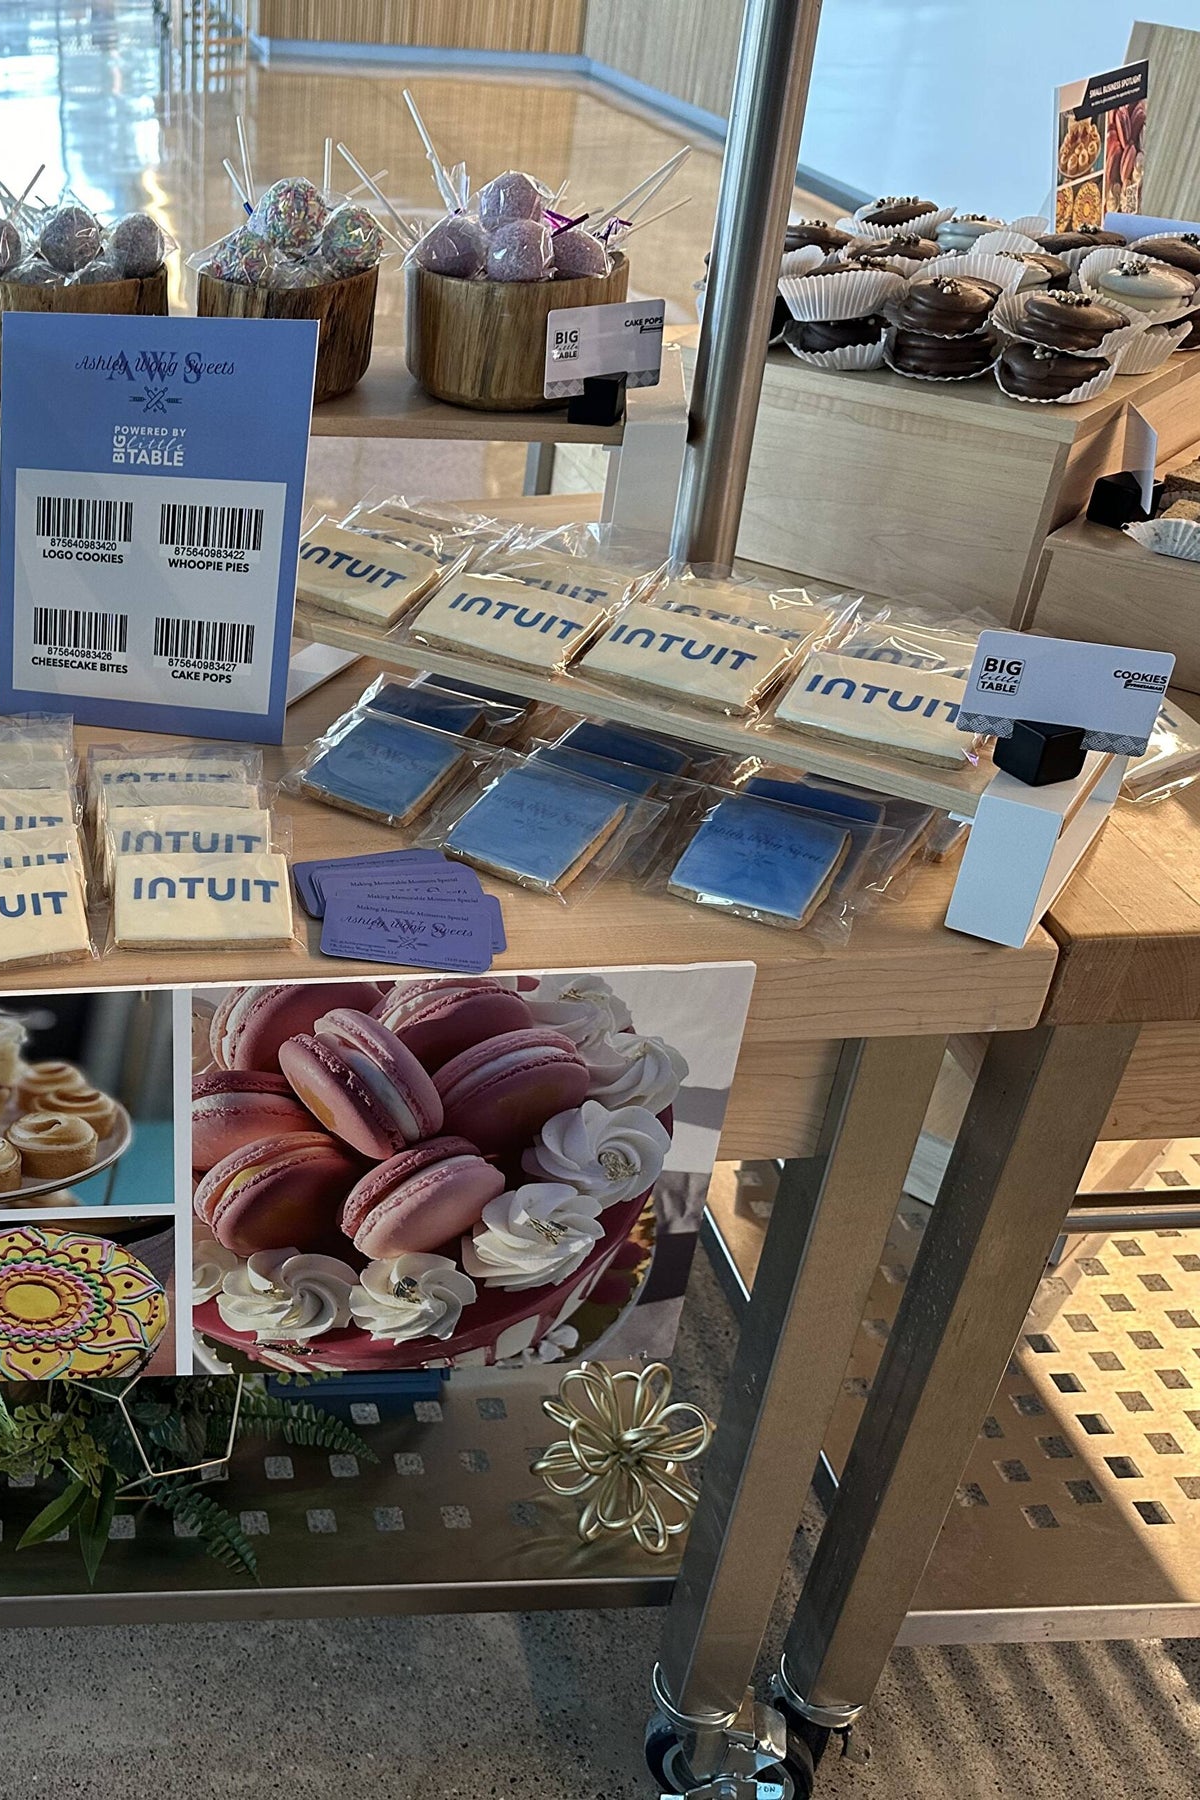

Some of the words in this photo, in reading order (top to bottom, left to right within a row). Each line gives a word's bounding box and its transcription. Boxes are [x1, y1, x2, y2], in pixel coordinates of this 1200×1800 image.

[624, 319, 642, 327] CAKE
[644, 317, 663, 325] POPS
[556, 330, 578, 344] BIG
[554, 350, 577, 359] ABLE
[114, 425, 168, 437] POWERED
[171, 428, 186, 437] BY
[112, 435, 127, 463] BIG
[126, 435, 185, 452] little
[128, 449, 184, 467] TABLE
[50, 538, 117, 553] 875640983420
[174, 546, 245, 560] 875640983422
[42, 550, 73, 562] LOGO
[76, 552, 124, 565] COOKIES
[300, 542, 407, 588] INTUIT
[168, 558, 223, 572] WHOOPIE
[225, 562, 249, 573] PIES
[448, 592, 584, 640] INTUIT
[47, 646, 113, 661] 875640983426
[609, 624, 758, 671] INTUIT
[31, 656, 97, 672] CHEESECAKE
[100, 661, 128, 674] BITES
[167, 657, 237, 673] 875640983427
[984, 657, 1023, 675] BIG
[171, 670, 200, 682] CAKE
[203, 672, 232, 684] POPS
[1113, 669, 1167, 684] COOKIES
[980, 681, 1017, 693] TABLE
[805, 674, 961, 723] INTUIT
[121, 830, 262, 853] INTUIT
[134, 877, 279, 903] INTUIT
